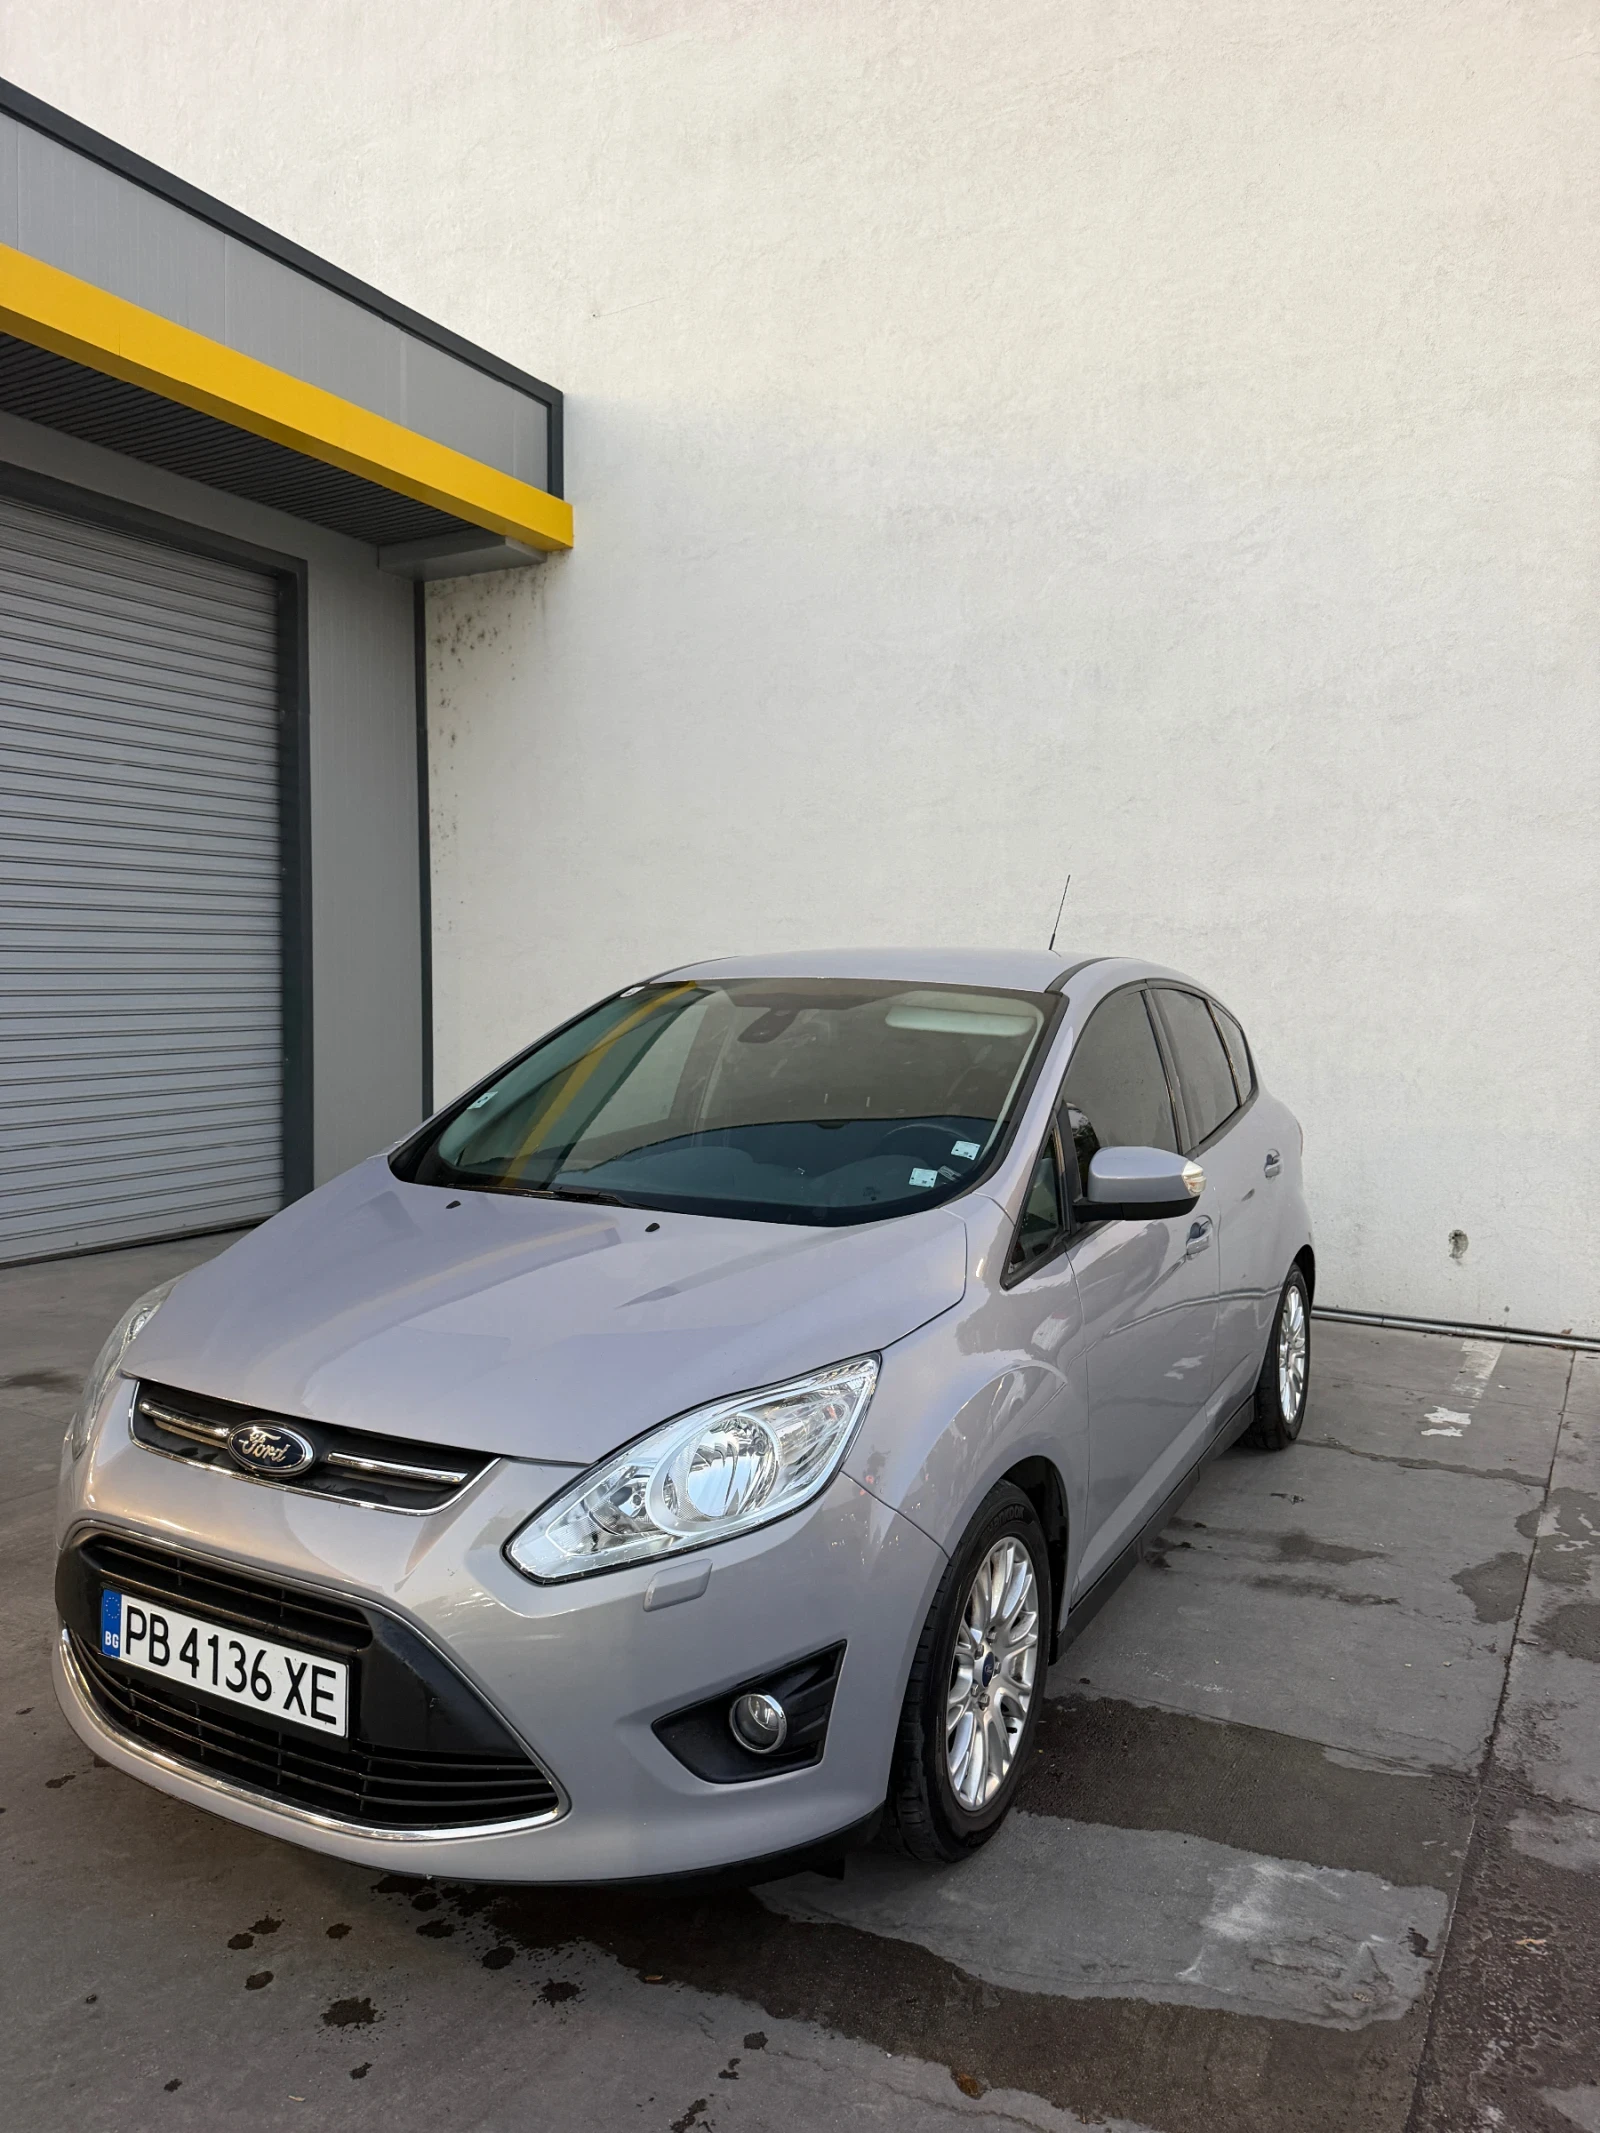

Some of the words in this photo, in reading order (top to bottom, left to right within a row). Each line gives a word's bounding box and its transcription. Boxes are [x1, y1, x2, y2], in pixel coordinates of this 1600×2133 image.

[239, 1428, 291, 1462] Ford
[105, 1630, 119, 1649] BG
[125, 1604, 170, 1667] PB
[180, 1627, 272, 1702] 4136
[283, 1656, 337, 1726] XE
